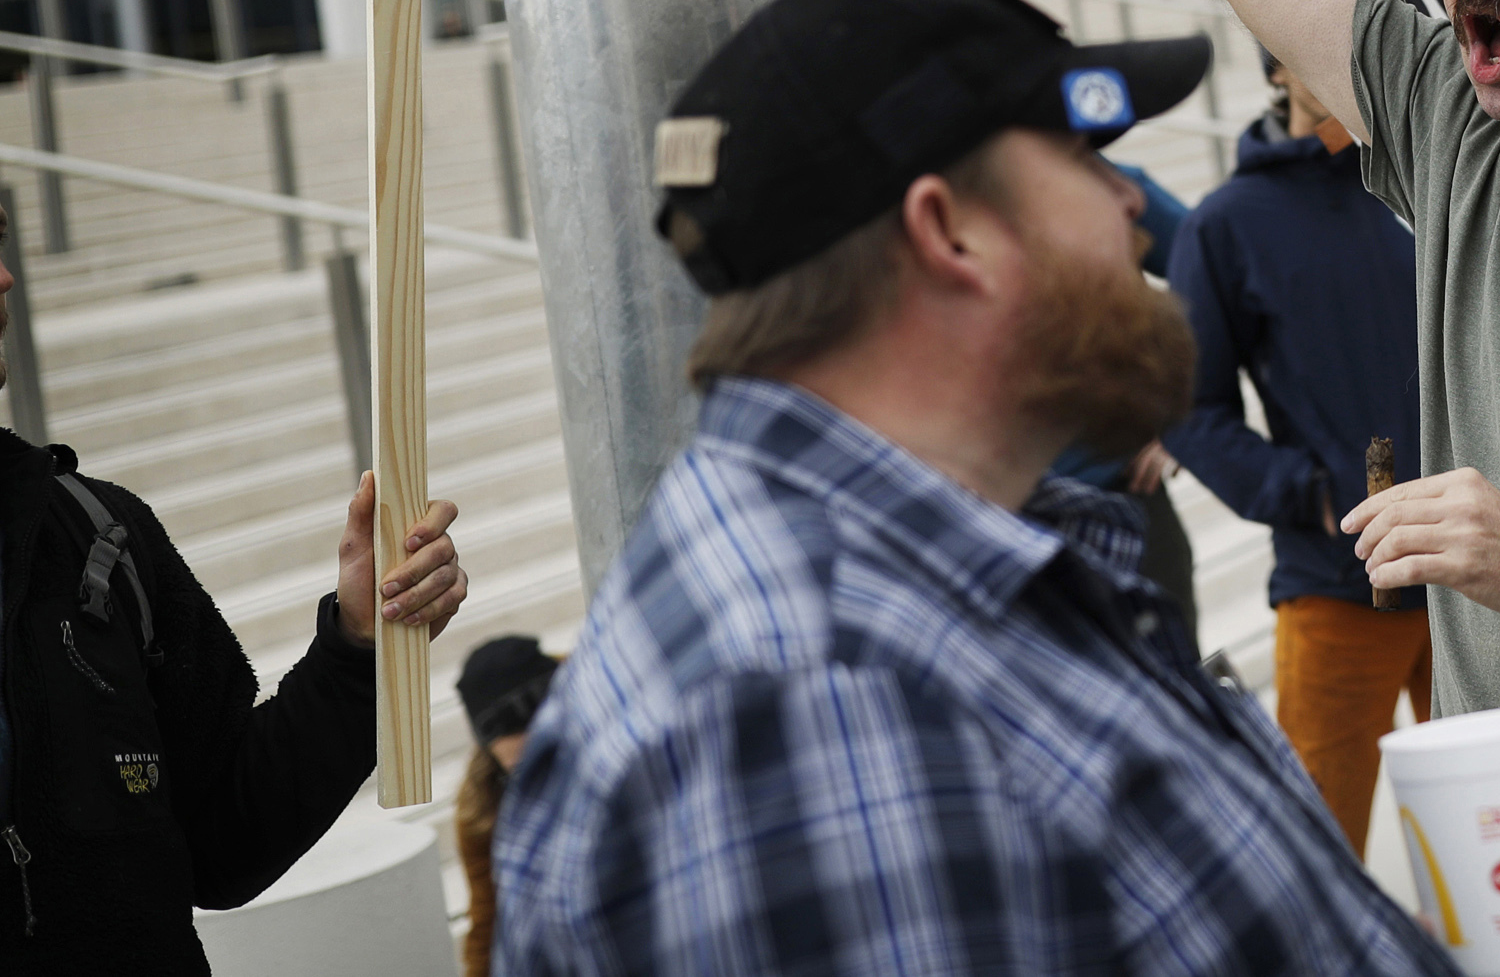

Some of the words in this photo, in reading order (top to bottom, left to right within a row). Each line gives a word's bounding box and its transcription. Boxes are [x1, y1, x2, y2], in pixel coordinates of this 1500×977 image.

[114, 753, 160, 762] MOUNTAIN
[119, 763, 143, 779] HARD
[126, 778, 150, 794] WEAR
